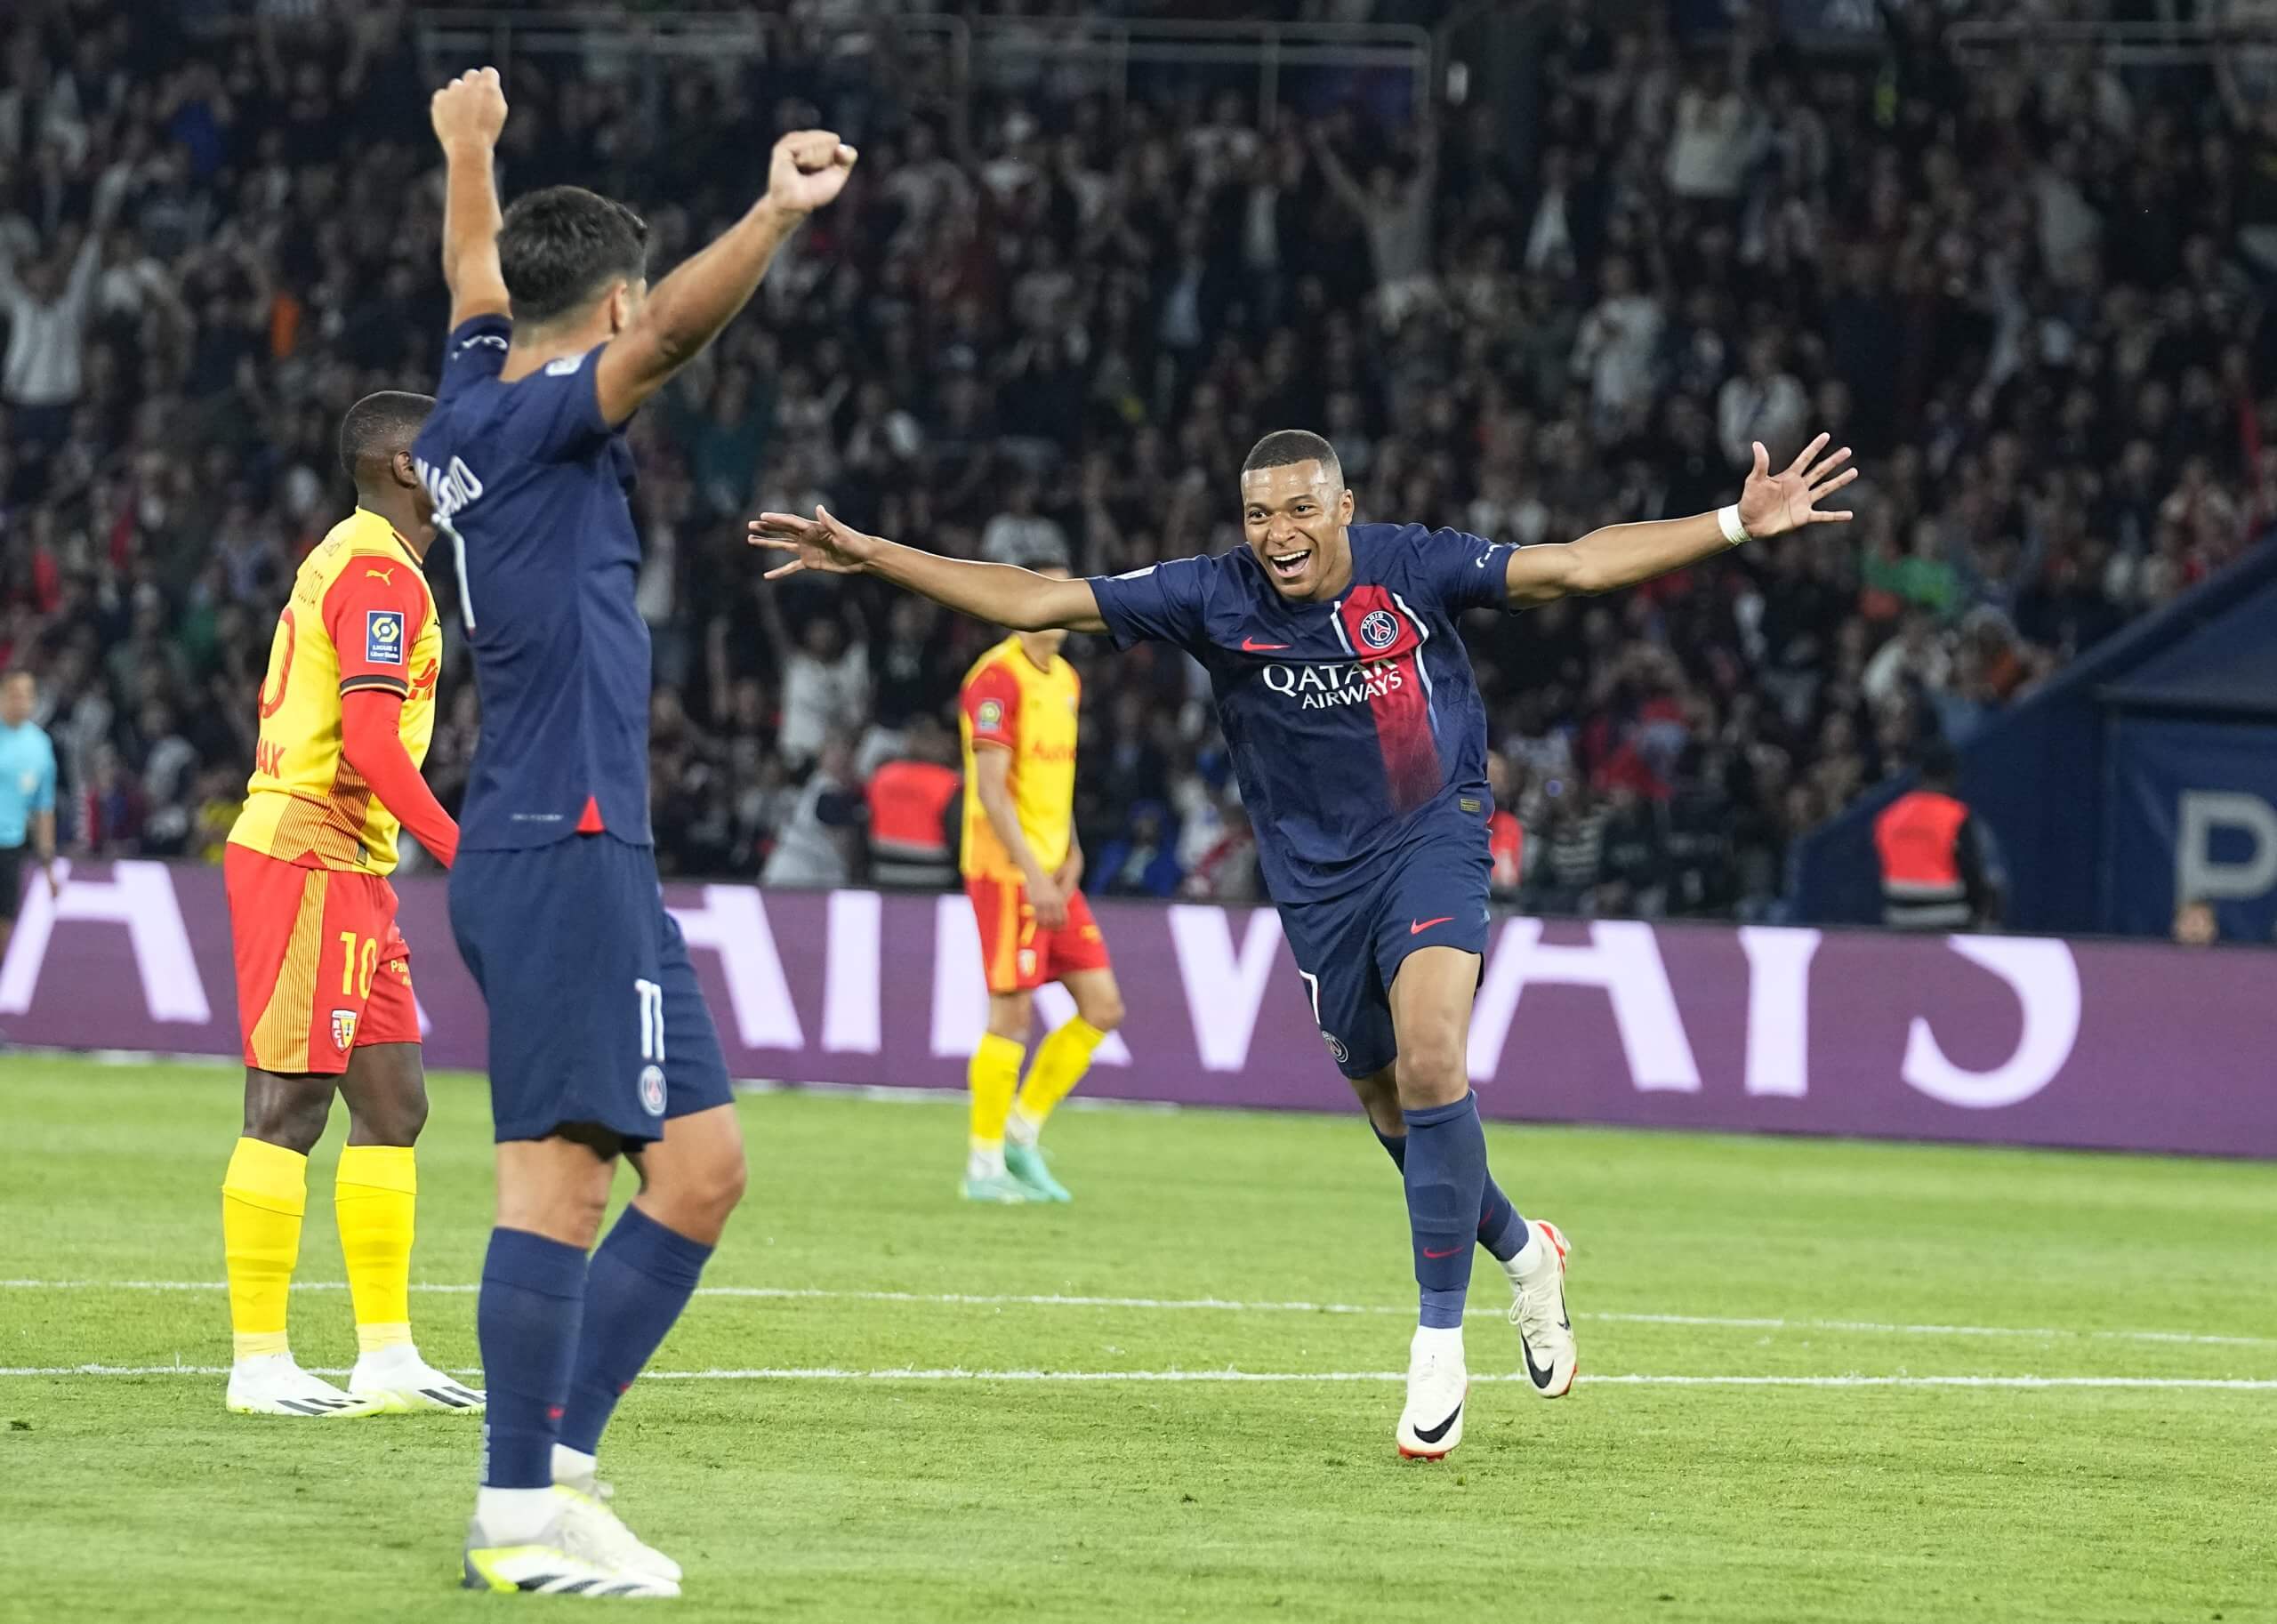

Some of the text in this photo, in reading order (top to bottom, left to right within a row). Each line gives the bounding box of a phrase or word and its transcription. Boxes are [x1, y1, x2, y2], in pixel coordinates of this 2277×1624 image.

[1362, 612, 1384, 629] PARIS
[1262, 658, 1398, 697] QATAR
[1301, 671, 1403, 710] AIRWAYS
[339, 931, 377, 1000] 10
[634, 978, 664, 1062] 11
